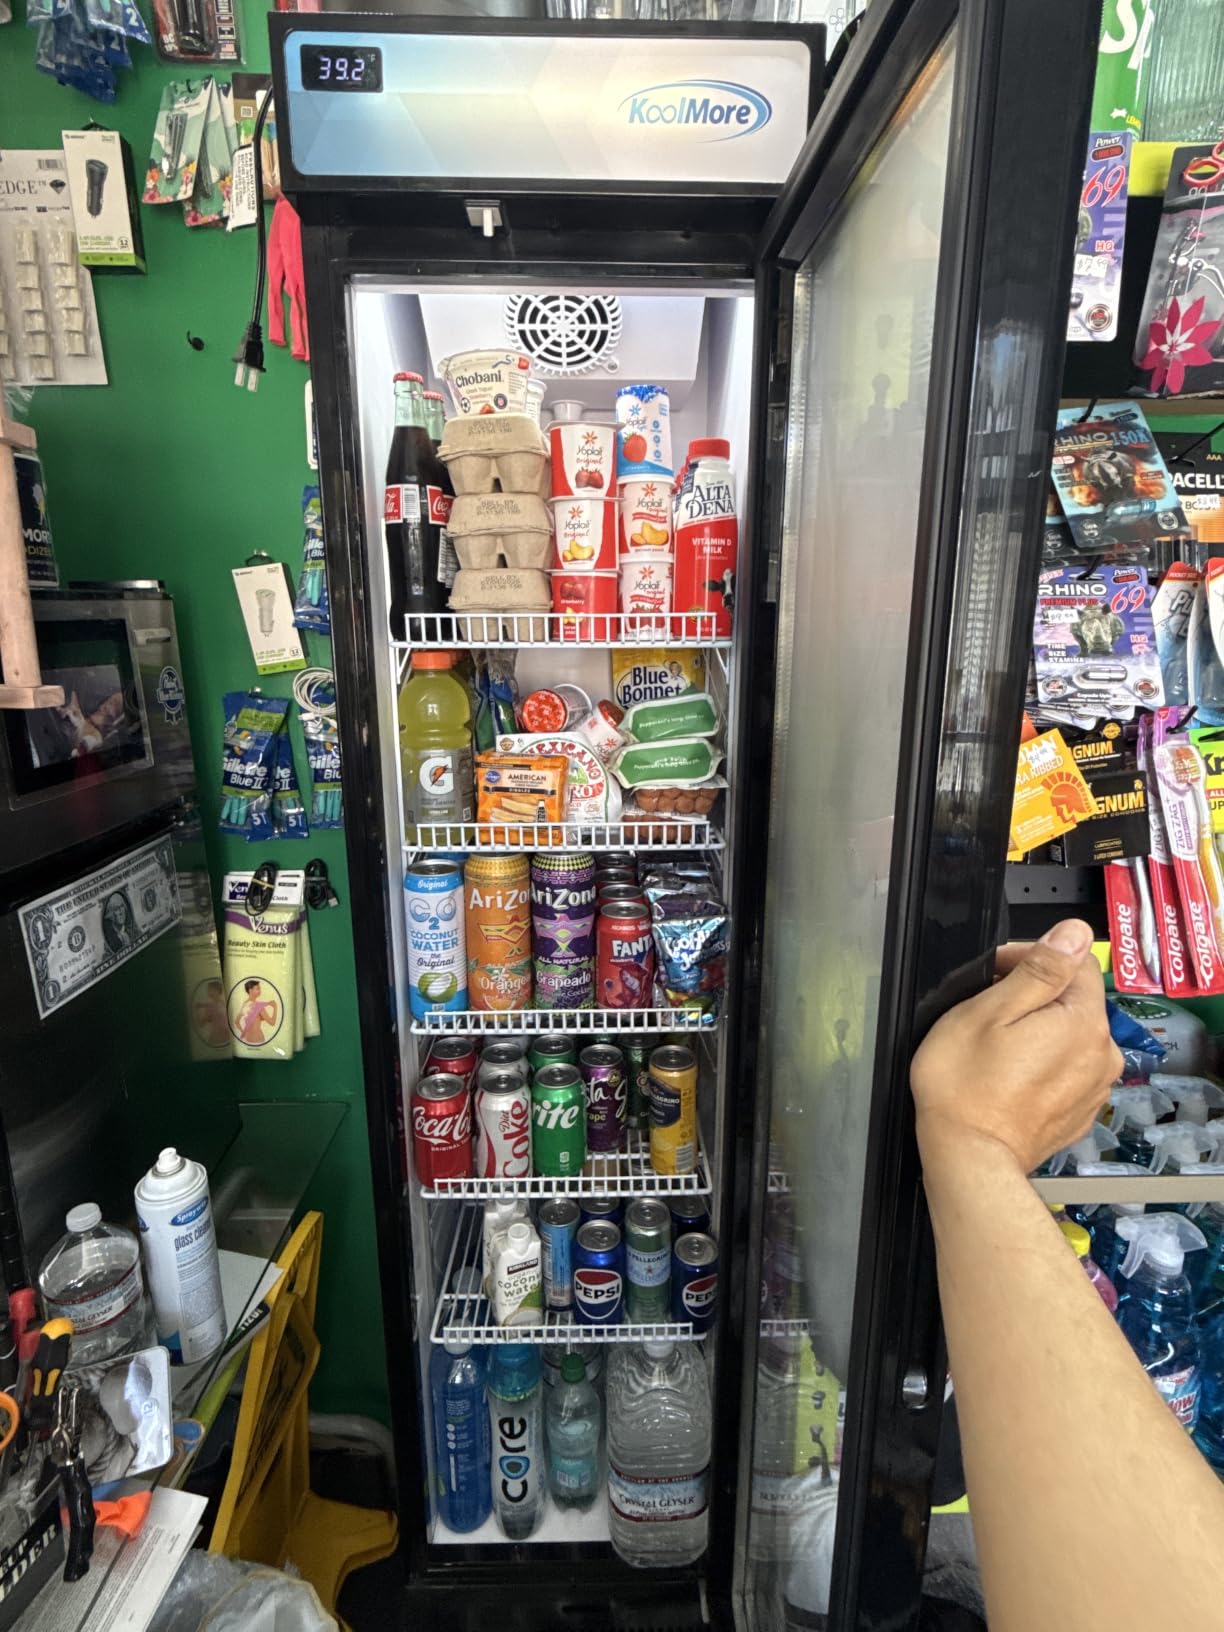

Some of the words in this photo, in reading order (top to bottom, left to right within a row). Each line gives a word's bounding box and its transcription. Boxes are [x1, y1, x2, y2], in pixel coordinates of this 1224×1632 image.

[319, 56, 365, 80] 39.2
[628, 97, 751, 125] KoolMore
[1081, 165, 1127, 208] 69
[1095, 239, 1115, 252] HQ
[455, 370, 505, 388] Chobani
[576, 446, 603, 461] Yoplait
[1206, 453, 1222, 461] AAA
[692, 484, 732, 502] ALTA
[636, 497, 663, 511] Yoplait
[685, 500, 735, 519] DENA
[564, 519, 591, 532] Yoplait
[692, 538, 725, 547] VITAMIN
[703, 546, 723, 555] MILK
[634, 580, 661, 594] Yoplait
[1038, 584, 1107, 596] RHINO
[1110, 586, 1146, 614] 69
[632, 665, 669, 686] Blue
[622, 684, 682, 706] Bonnet
[230, 773, 253, 786] Blue
[508, 774, 547, 782] AMERICAN
[417, 879, 449, 890] Original
[249, 914, 289, 934] Venus
[410, 928, 460, 940] COCONUT
[227, 939, 250, 948] Beauty
[411, 939, 459, 952] WATER
[1118, 903, 1139, 982] Colgate
[1165, 904, 1186, 987] Colgate
[1190, 901, 1215, 989] Colgate
[416, 957, 455, 970] Original
[552, 956, 589, 965] NATURAL
[498, 1110, 511, 1133] Diet
[503, 1100, 530, 1178] Coke
[431, 1143, 460, 1152] ORIGINAL
[174, 1232, 195, 1251] glass
[575, 1280, 620, 1300] PEPSI
[498, 1416, 531, 1504] core
[619, 1494, 657, 1509] CRYSTAL
[658, 1495, 696, 1508] GEYSER
